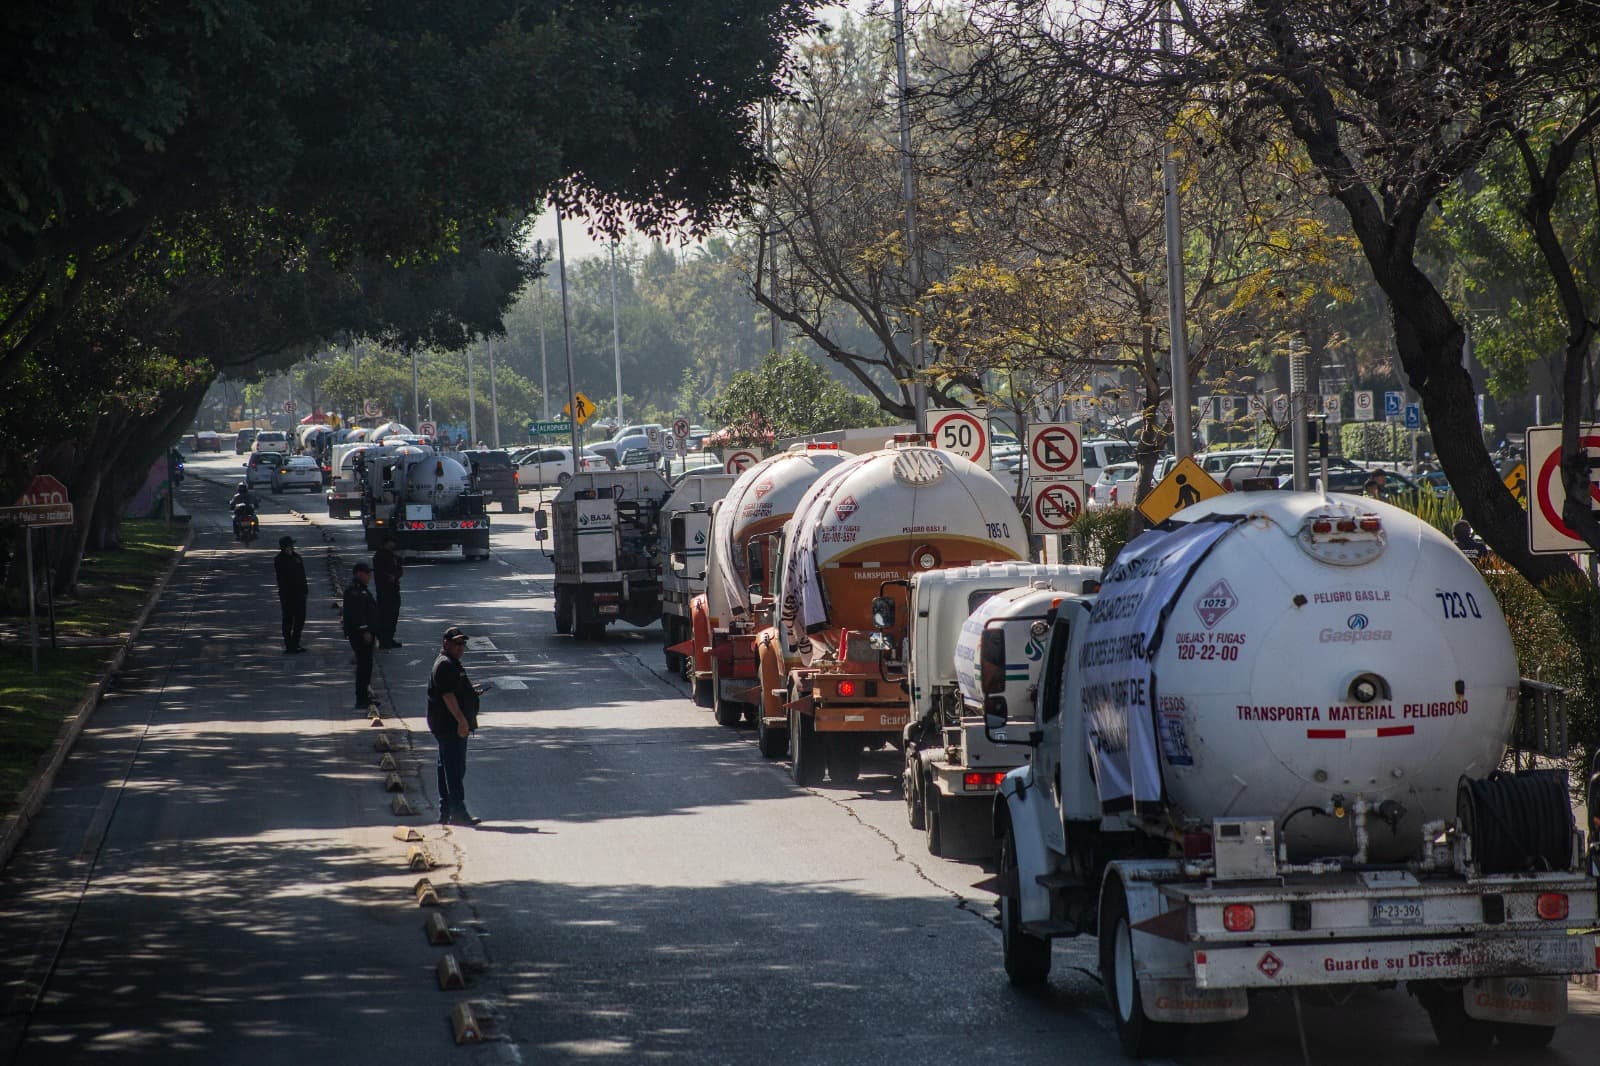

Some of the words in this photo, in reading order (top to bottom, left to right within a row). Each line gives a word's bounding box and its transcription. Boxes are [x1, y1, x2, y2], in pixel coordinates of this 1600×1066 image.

[540, 424, 571, 432] AEROPUERT
[944, 425, 972, 449] 50
[590, 514, 611, 522] BAJA
[986, 523, 1001, 539] 785
[853, 570, 899, 580] TRANSPORTA
[1203, 599, 1228, 608] 1075
[1313, 590, 1352, 604] PELIGRO
[1355, 590, 1375, 602] GAS
[1435, 591, 1467, 619] 723
[1206, 612, 1214, 622] 2
[1175, 632, 1206, 645] QUEJAS
[1207, 632, 1214, 644] Y
[1215, 632, 1247, 645] FUGAS
[1318, 628, 1393, 645] Gaspasa
[1177, 644, 1239, 661] 120-22-00
[1130, 678, 1146, 706] DE
[1159, 695, 1186, 712] PESOS
[1236, 705, 1321, 721] TRANSPORTA
[1328, 704, 1396, 721] MATERIAL
[1403, 699, 1469, 719] PELIGROSO
[1372, 904, 1421, 919] AP-23-396
[1323, 956, 1379, 972] Guarde
[1385, 957, 1404, 969] su
